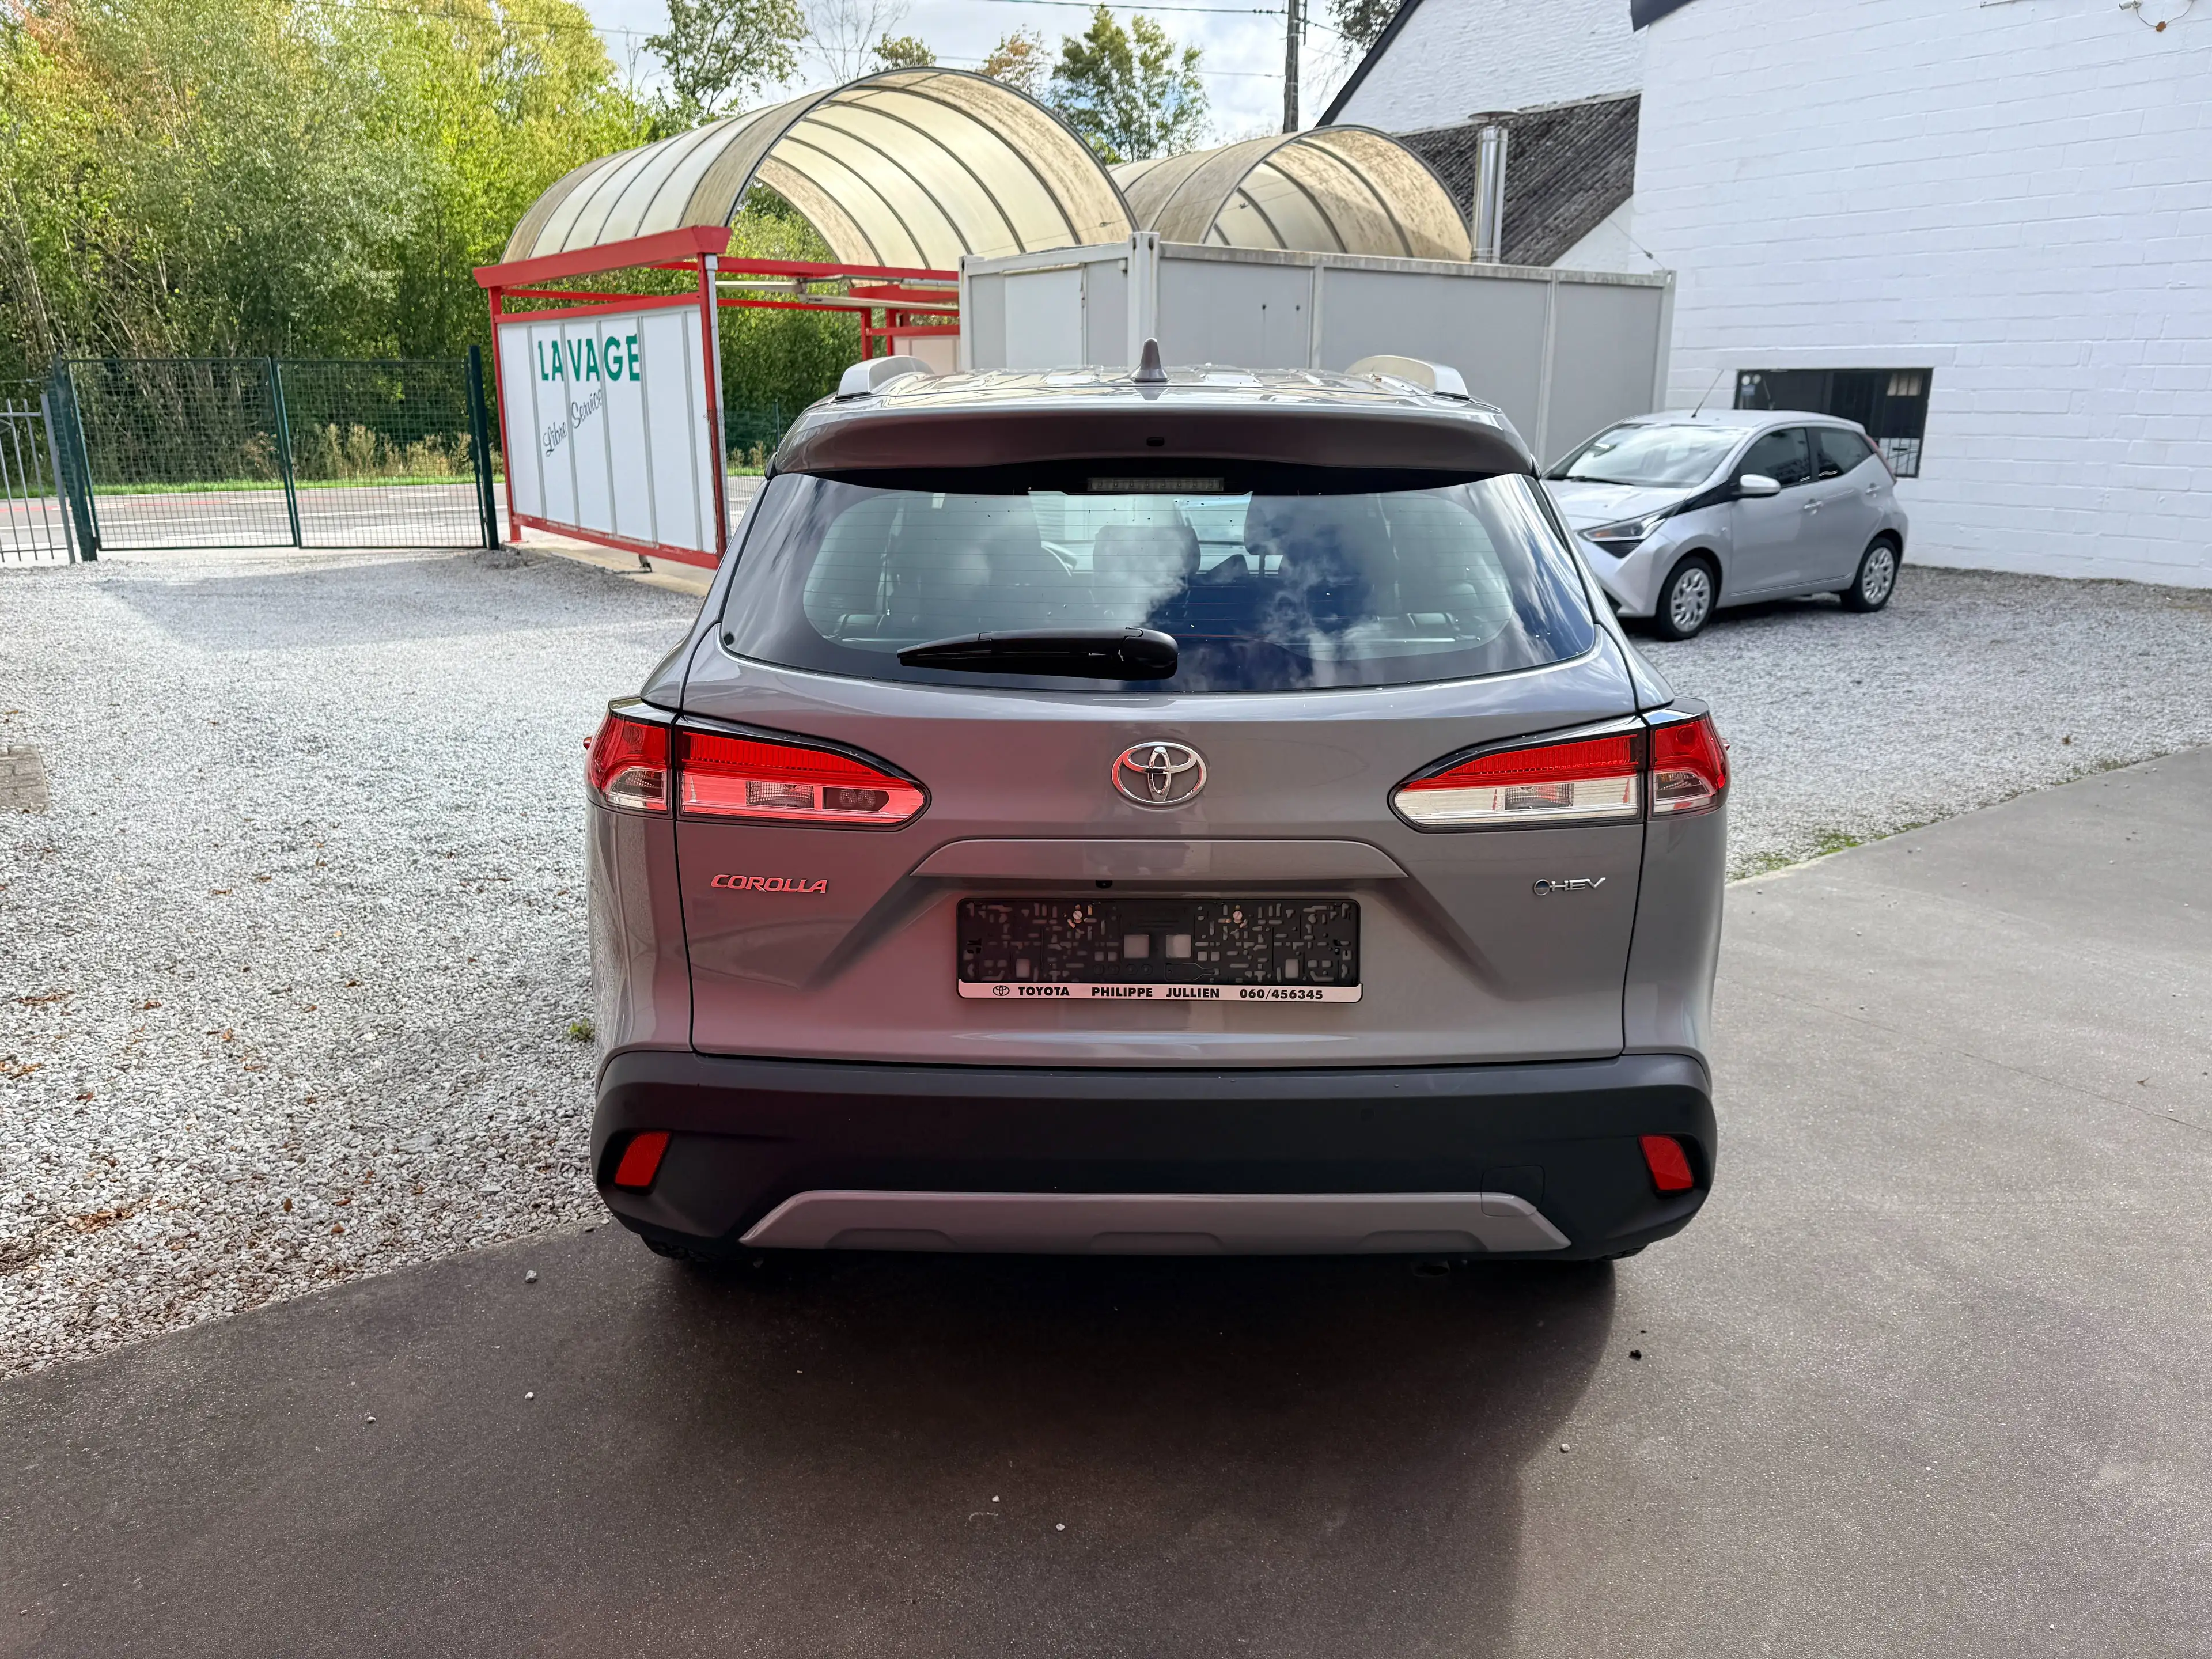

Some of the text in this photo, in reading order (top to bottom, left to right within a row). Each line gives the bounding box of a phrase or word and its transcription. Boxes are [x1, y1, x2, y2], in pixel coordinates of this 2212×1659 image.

[538, 334, 640, 381] LAVAGE
[543, 389, 602, 457] Libre Service
[711, 874, 827, 893] COROLLA
[1548, 877, 1606, 892] HEV
[1018, 986, 1323, 999] TOYOTA PHILIPPE JULLIEN 060/456345
